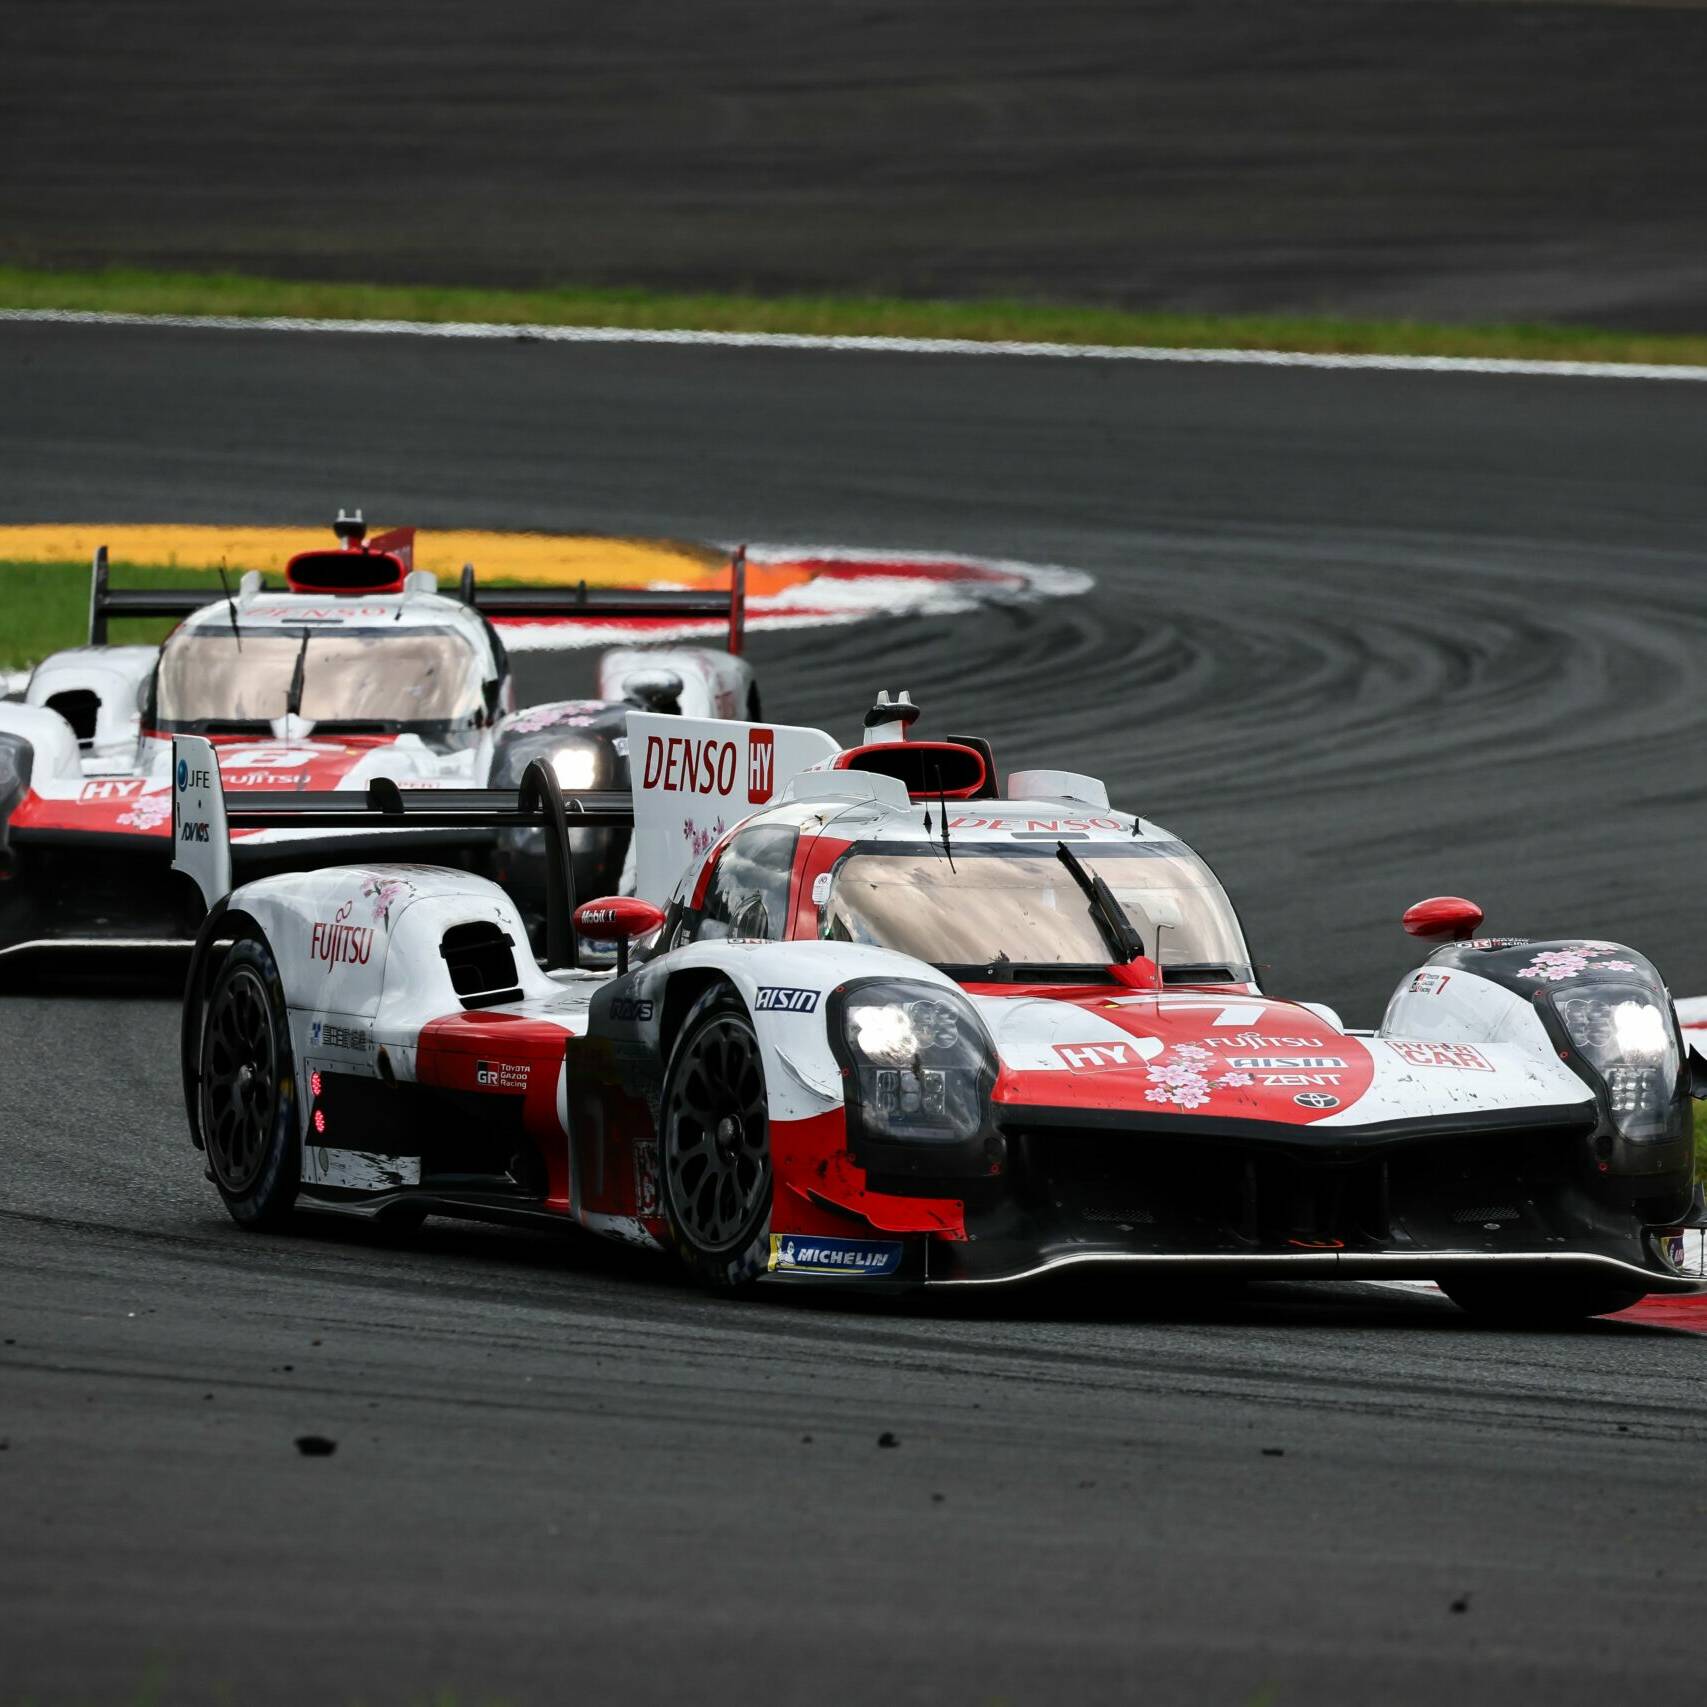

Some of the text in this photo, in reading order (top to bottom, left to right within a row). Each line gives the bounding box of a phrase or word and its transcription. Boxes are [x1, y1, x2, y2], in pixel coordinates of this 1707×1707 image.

[643, 735, 737, 796] DENSO
[749, 742, 772, 791] HY
[188, 770, 210, 789] JFE
[82, 781, 141, 800] HY
[949, 817, 1121, 831] DENSO
[581, 910, 605, 924] Mobil
[311, 922, 375, 974] FUJITSU
[1436, 975, 1451, 995] 7
[755, 988, 818, 1011] AISIN
[610, 999, 654, 1021] RAYS
[1203, 1031, 1323, 1049] FUJITSU
[1393, 1042, 1473, 1054] HYPER
[1060, 1045, 1129, 1068] HY
[1232, 1057, 1343, 1068] AISIN
[1404, 1051, 1487, 1068] CAR
[478, 1070, 498, 1085] GR
[500, 1079, 527, 1090] Racing
[1257, 1073, 1342, 1086] ZENT
[797, 1248, 889, 1267] MICHELIN
